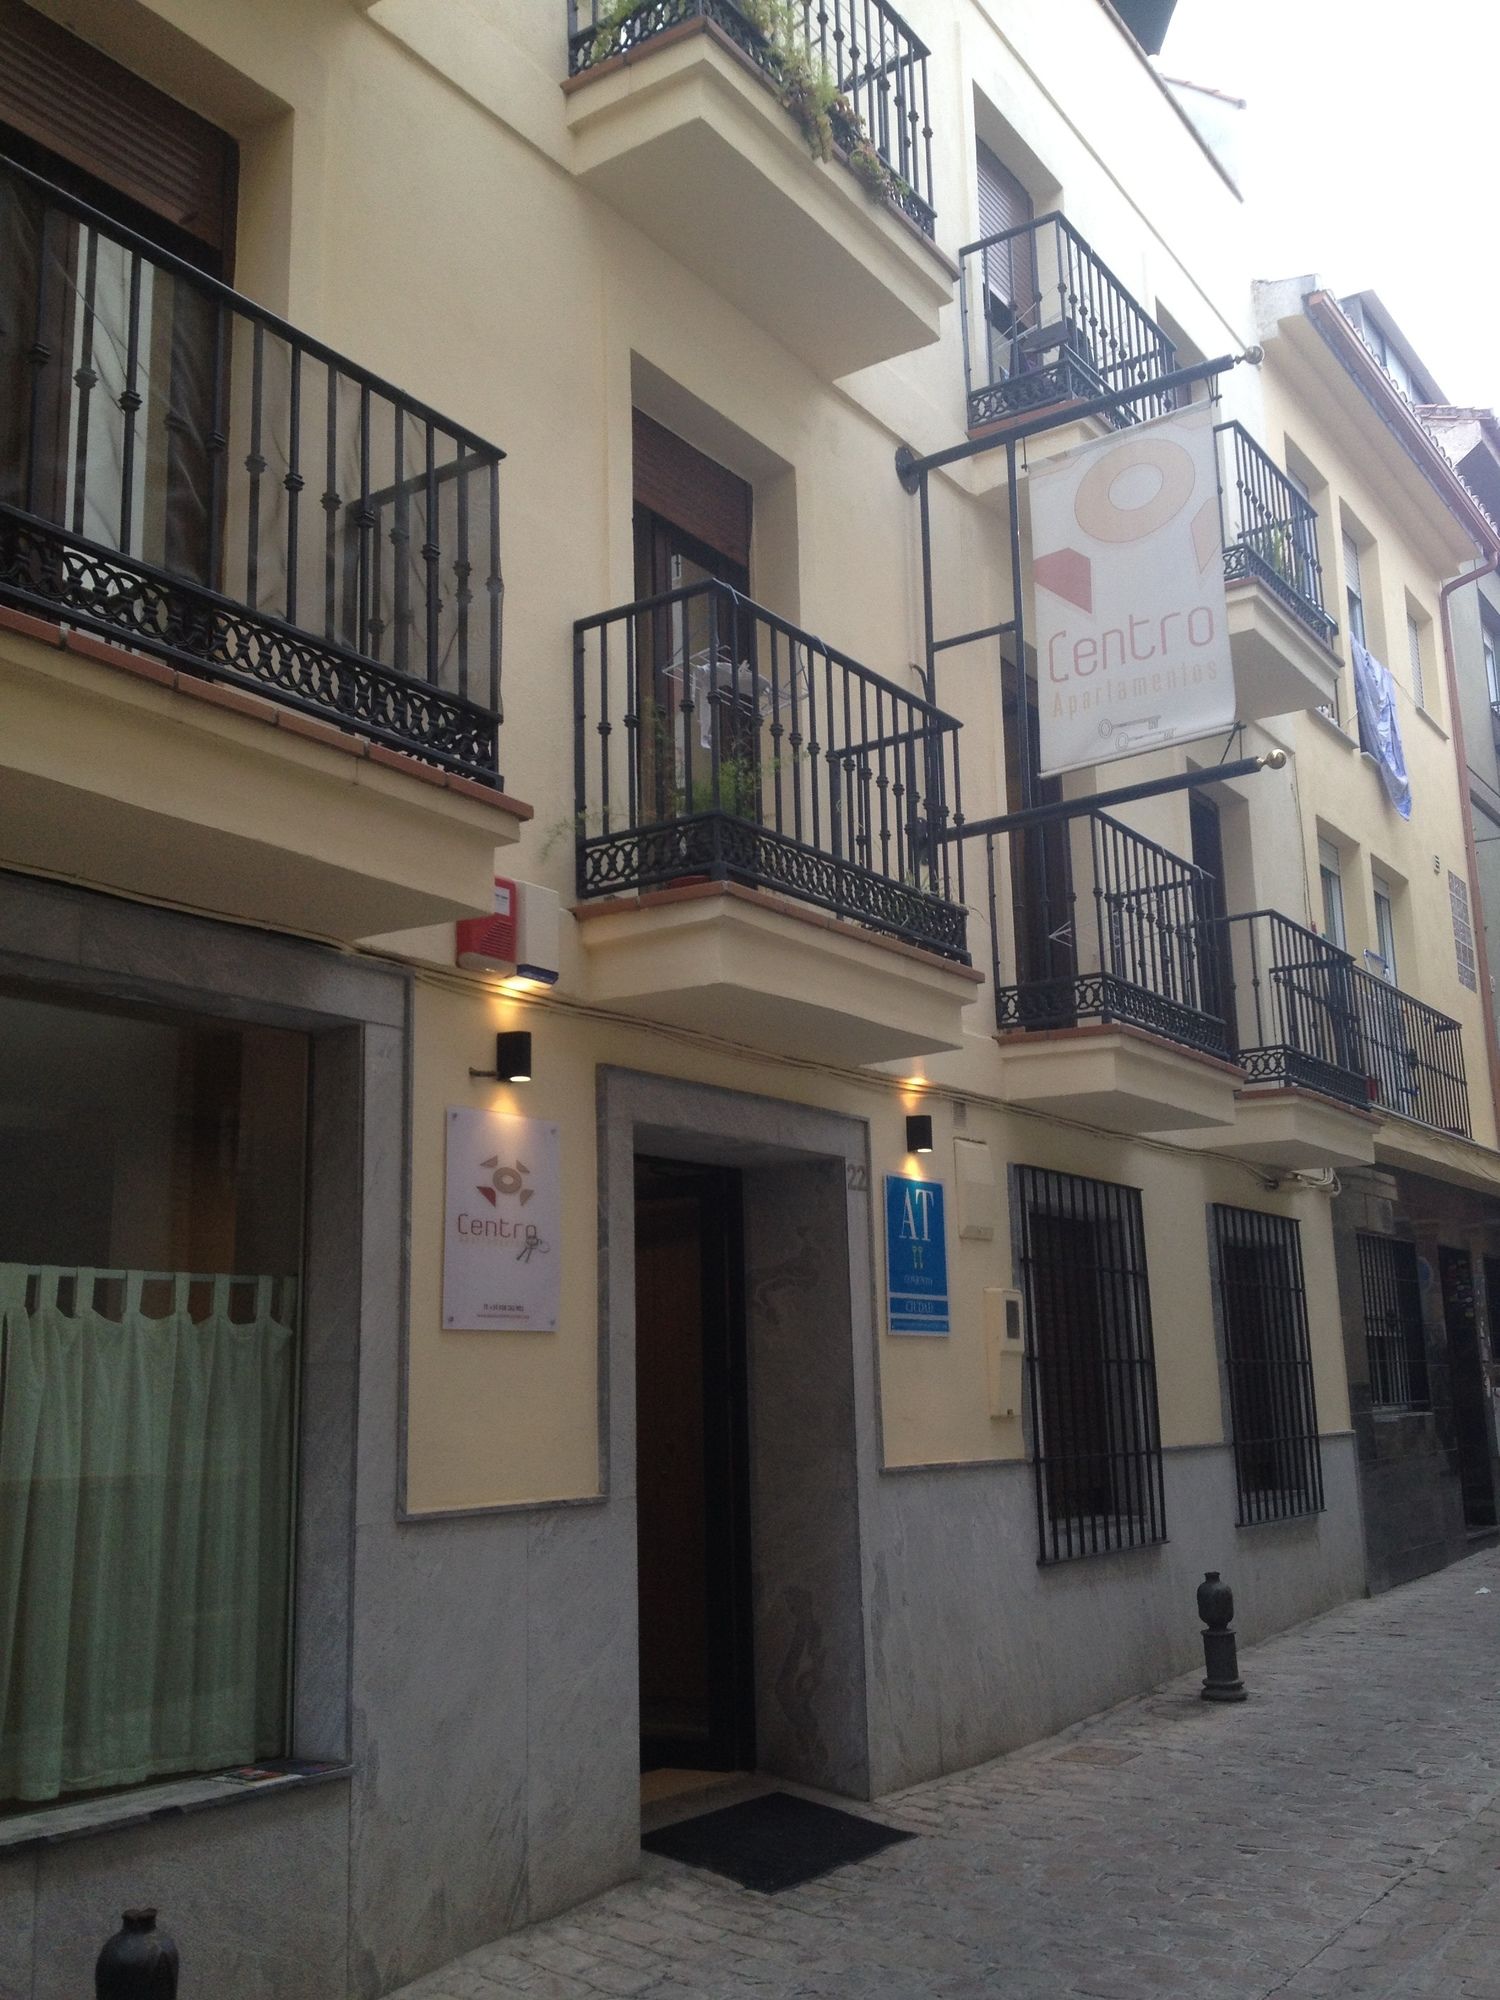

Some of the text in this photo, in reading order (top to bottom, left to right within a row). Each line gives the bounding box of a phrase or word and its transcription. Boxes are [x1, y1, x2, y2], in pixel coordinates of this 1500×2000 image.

[1048, 606, 1215, 683] Centro
[1052, 659, 1218, 720] Apartamentos
[458, 1213, 537, 1241] Centro
[899, 1186, 935, 1242] AT
